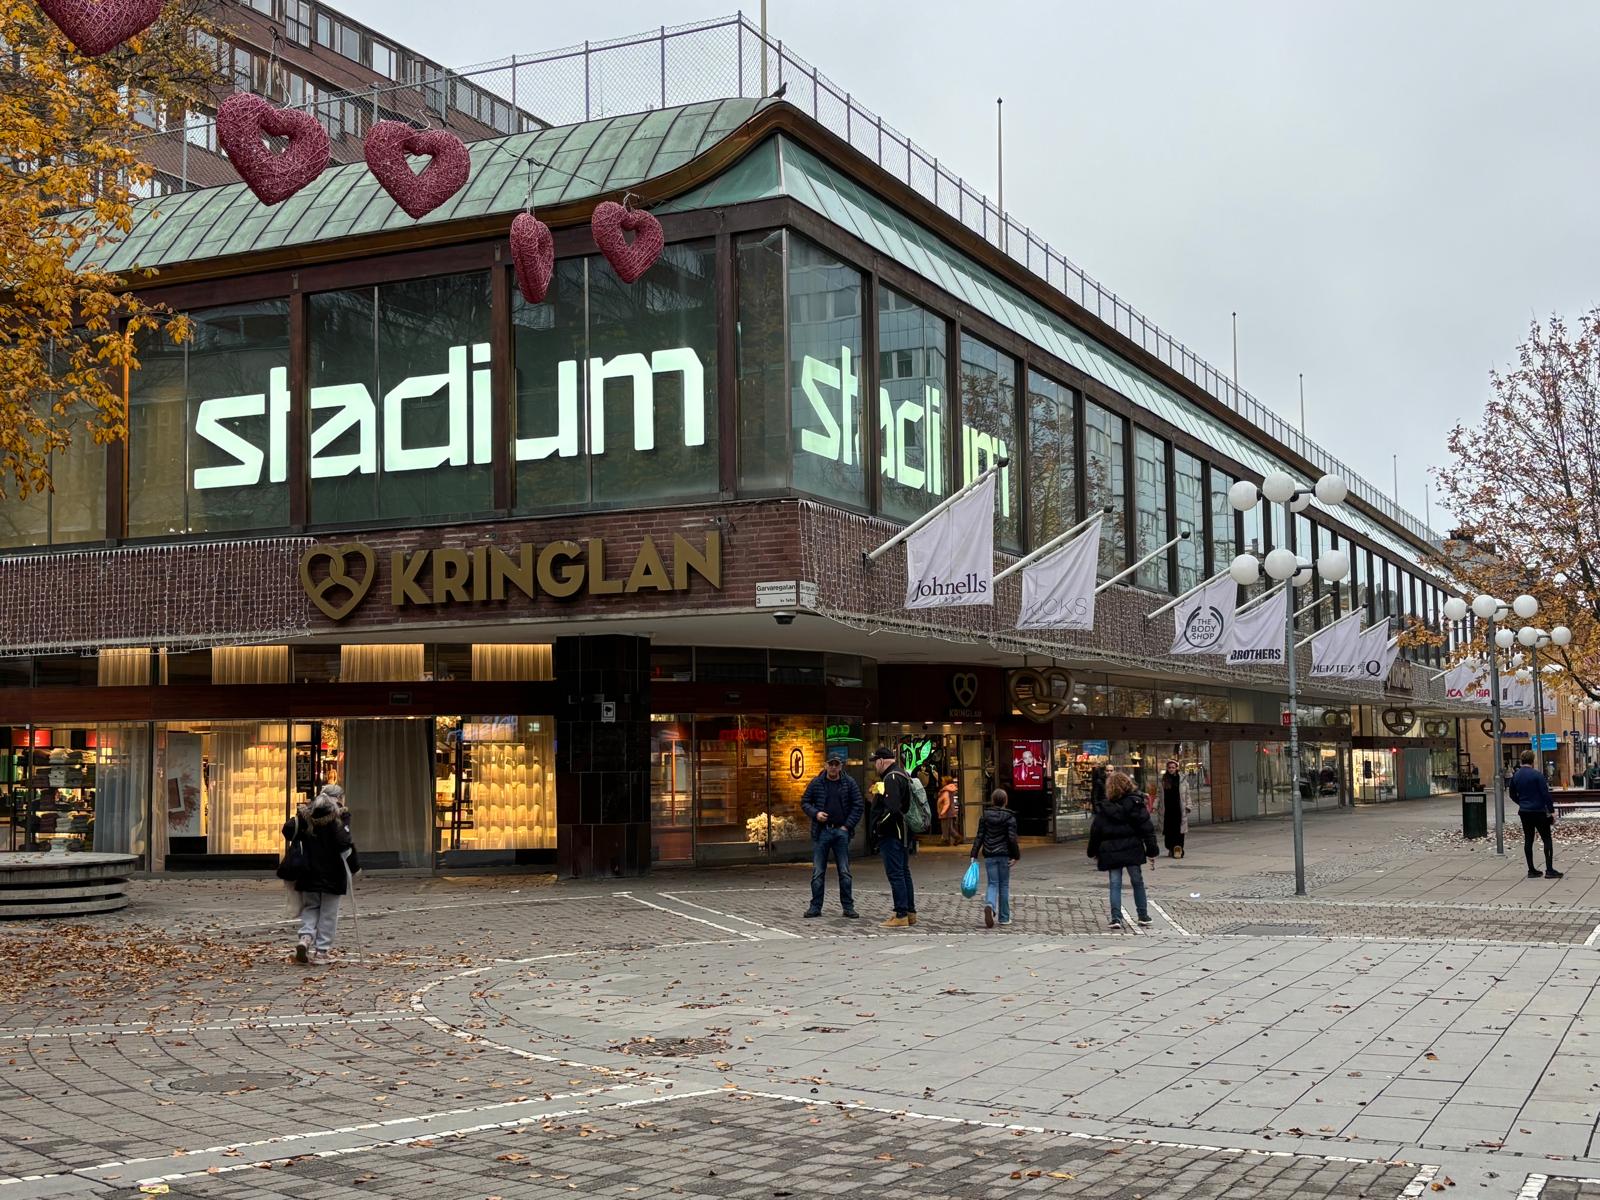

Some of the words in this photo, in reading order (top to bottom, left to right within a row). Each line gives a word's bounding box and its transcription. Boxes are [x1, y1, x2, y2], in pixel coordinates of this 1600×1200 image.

[193, 342, 705, 490] stadium
[391, 530, 722, 606] KRINGLAN
[912, 573, 987, 602] Johnells
[1025, 597, 1087, 616] KICKS
[1191, 625, 1216, 633] BODY
[1230, 648, 1281, 660] BROTHERS
